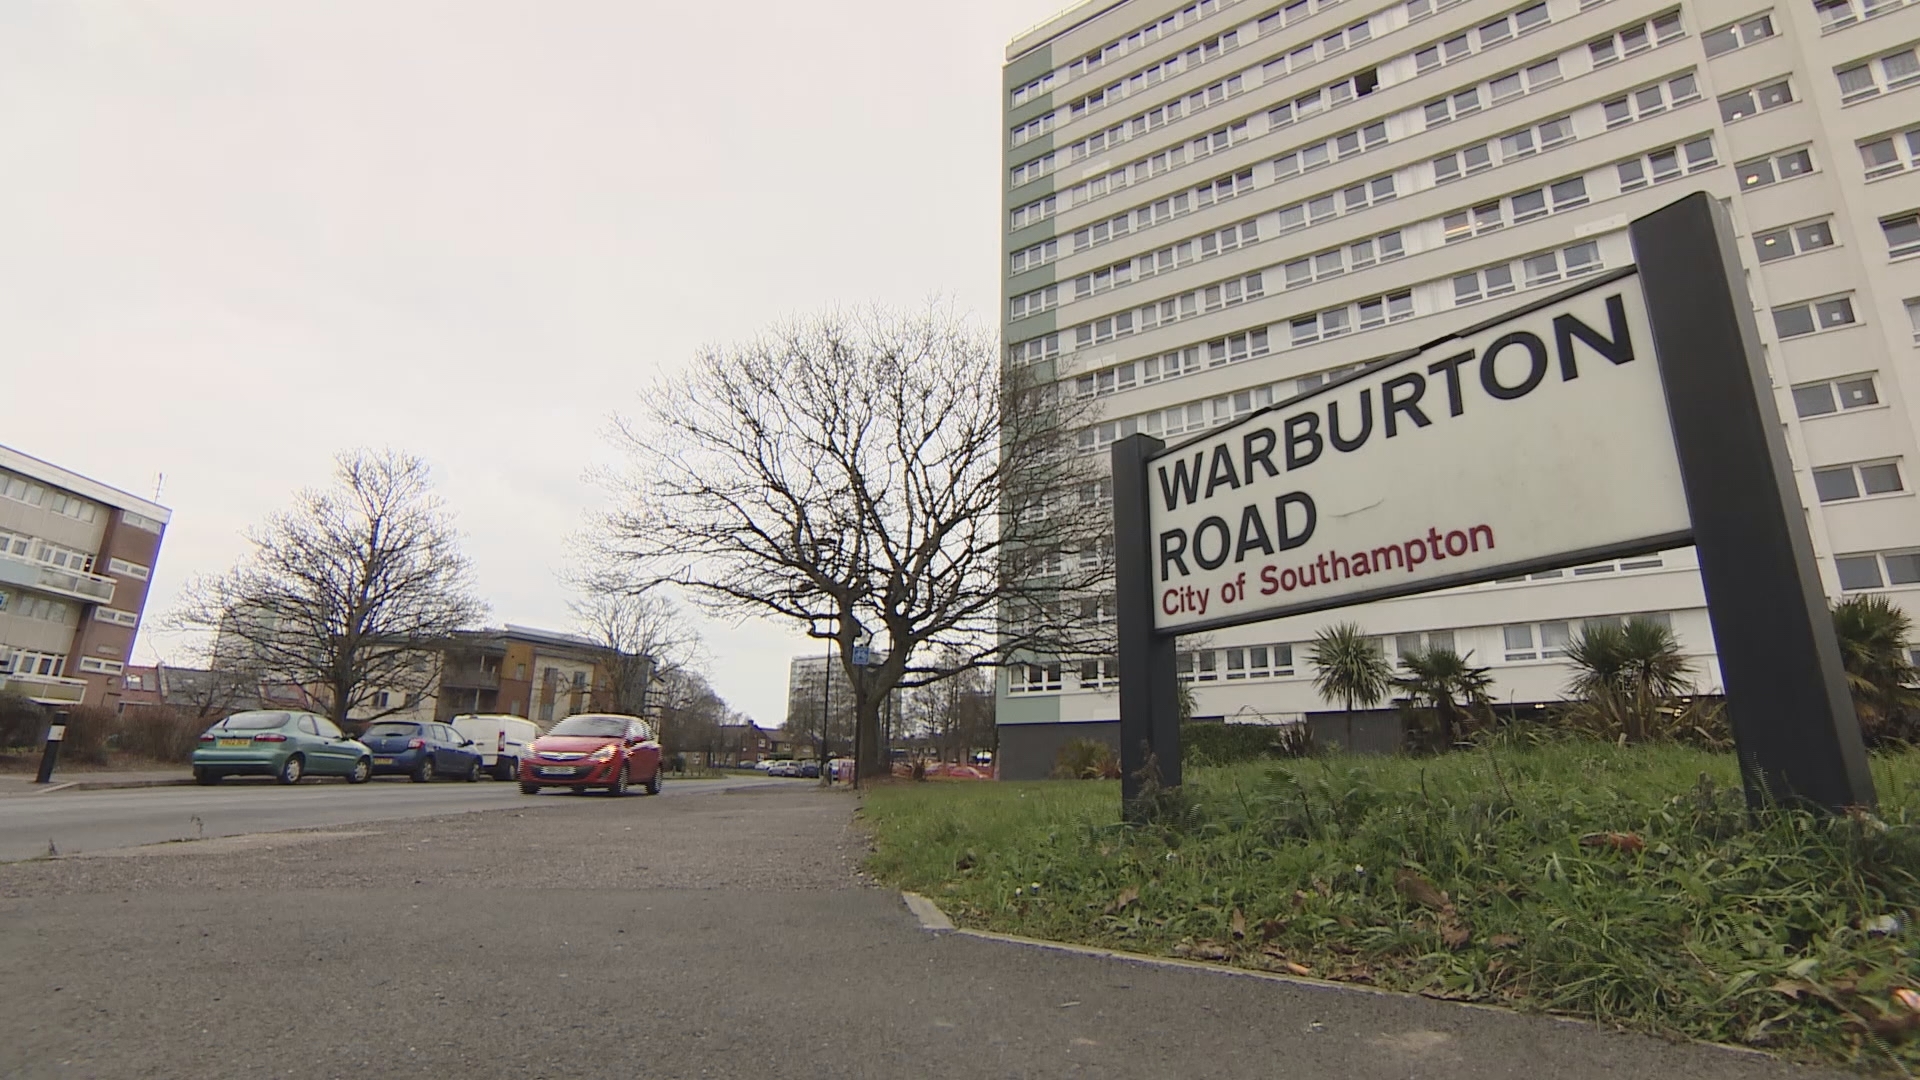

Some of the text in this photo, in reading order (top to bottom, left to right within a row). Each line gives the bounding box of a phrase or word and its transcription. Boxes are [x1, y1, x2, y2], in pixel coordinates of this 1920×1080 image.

[1157, 293, 1635, 512] WARBURTON
[1159, 491, 1317, 581] ROAD
[1162, 524, 1495, 615] City of Southampton
